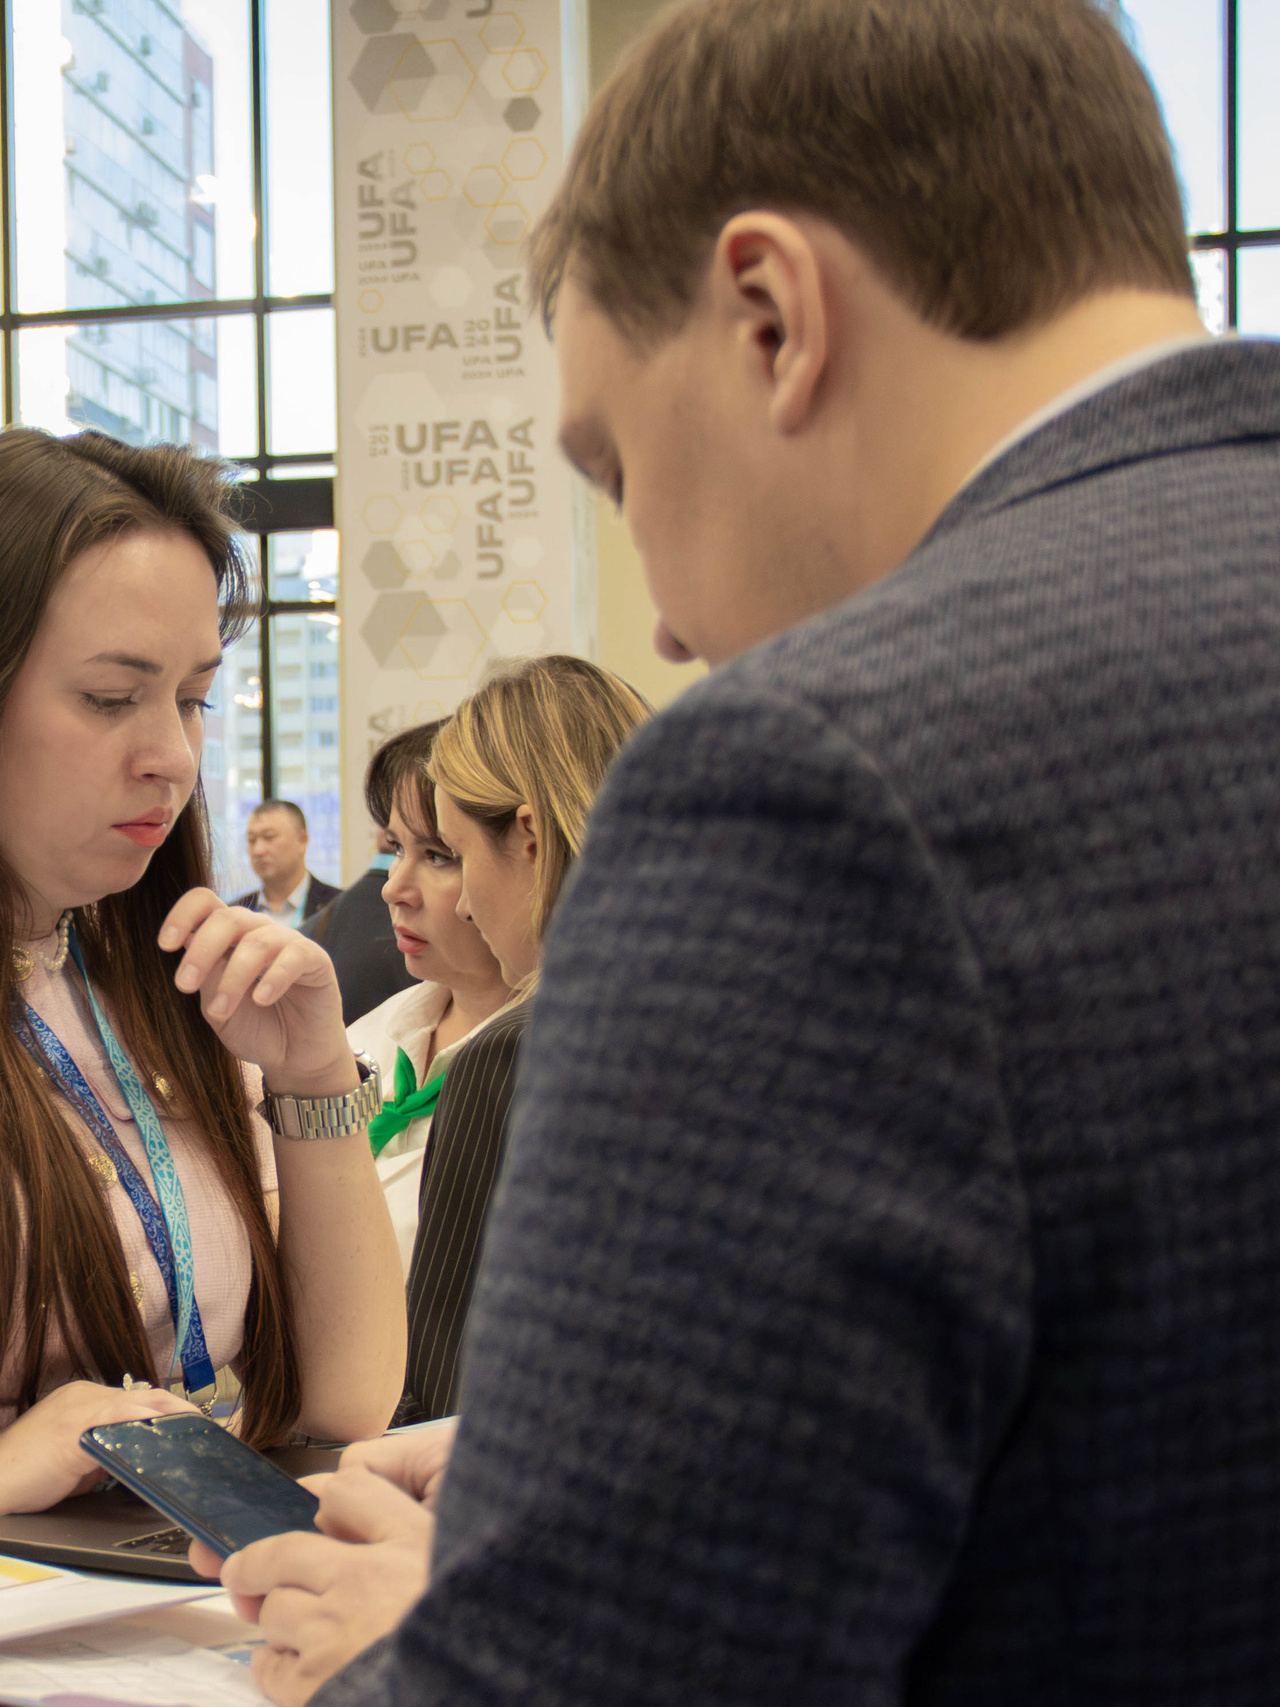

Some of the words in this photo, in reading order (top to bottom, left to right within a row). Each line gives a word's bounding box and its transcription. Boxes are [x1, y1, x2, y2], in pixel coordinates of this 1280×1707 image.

[357, 148, 385, 239] UFA
[388, 178, 417, 267] UFA
[371, 323, 458, 354] UFA
[493, 272, 522, 362] UFA
[395, 419, 499, 455] UFA
[414, 457, 502, 488] UFA
[507, 416, 535, 507] UFA
[476, 491, 505, 580] UFA
